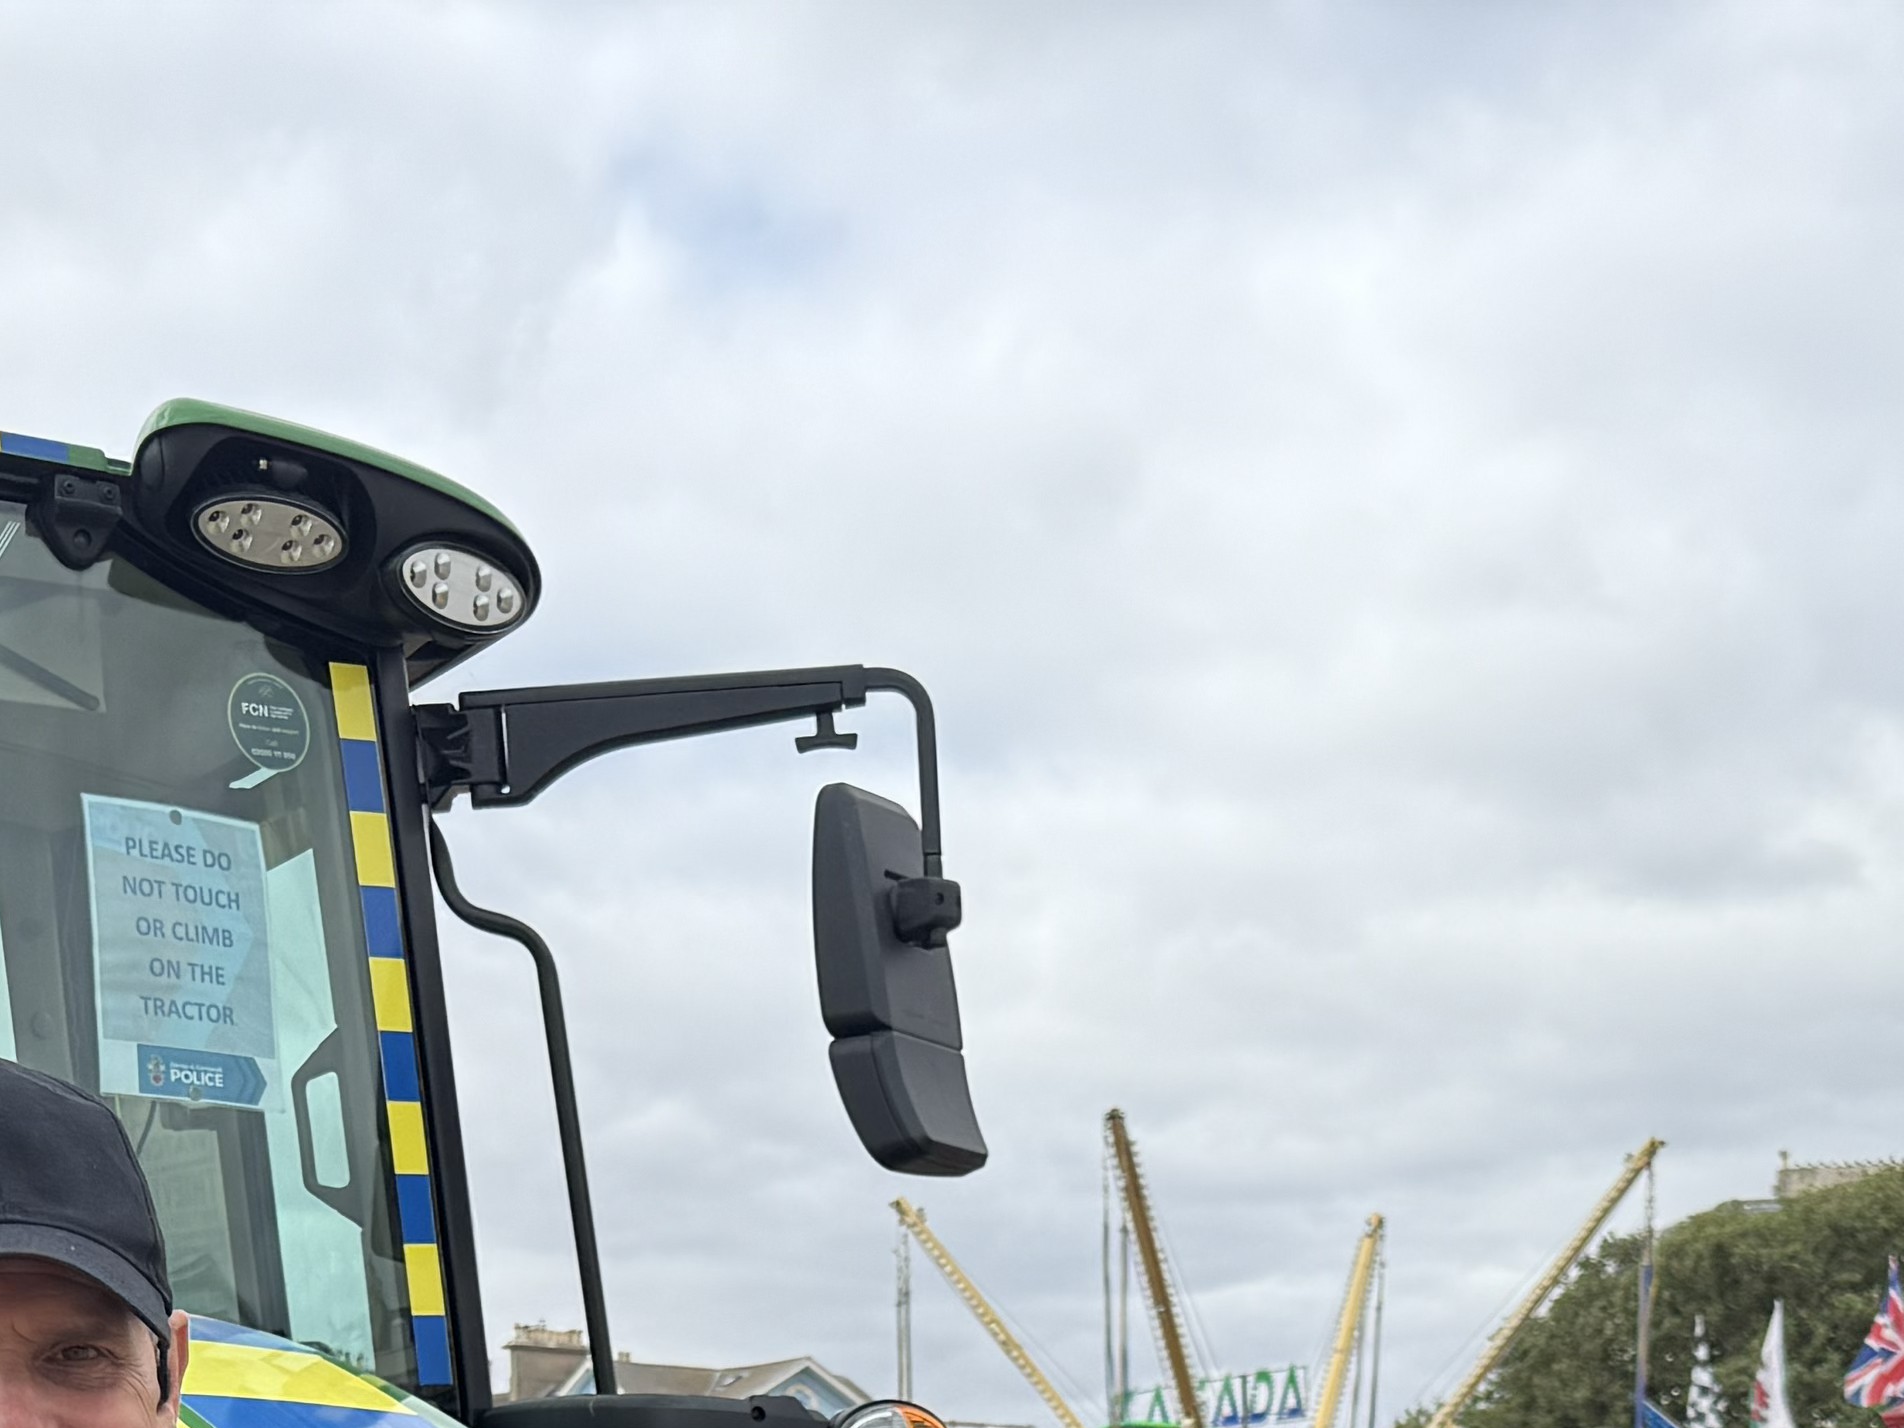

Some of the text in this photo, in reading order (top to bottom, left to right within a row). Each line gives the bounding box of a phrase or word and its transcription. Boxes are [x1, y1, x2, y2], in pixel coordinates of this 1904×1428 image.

[241, 702, 268, 717] FCN
[125, 836, 231, 871] PLEASE DO
[122, 875, 241, 911] NOT TOUCH
[135, 916, 234, 948] OR CLIMB
[149, 957, 226, 985] ON THE
[139, 996, 234, 1025] TRACTOR
[170, 1069, 224, 1088] POLICE
